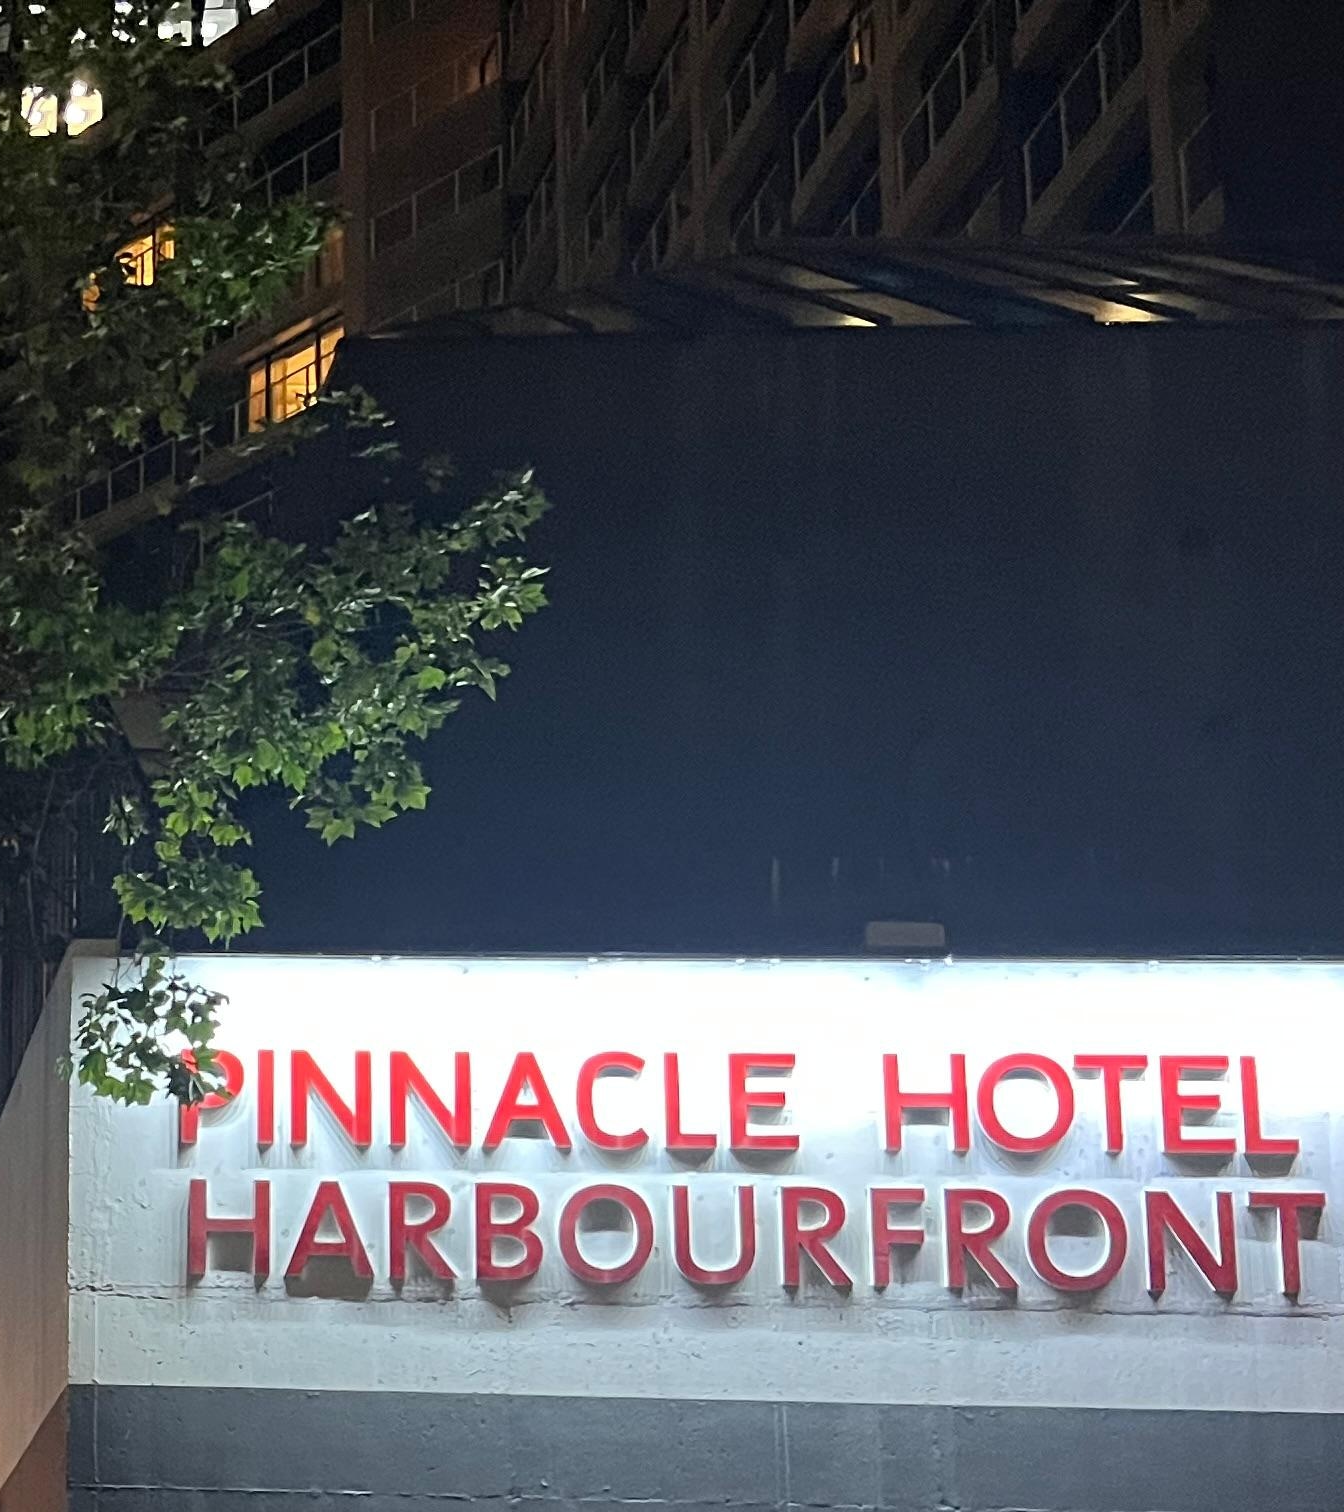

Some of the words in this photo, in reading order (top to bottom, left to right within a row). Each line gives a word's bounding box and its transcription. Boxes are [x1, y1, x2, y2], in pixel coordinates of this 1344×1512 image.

[179, 1048, 801, 1152] PINNACLE
[883, 1053, 1301, 1155] HOTEL
[187, 1178, 1327, 1298] HARBOURFRONT
